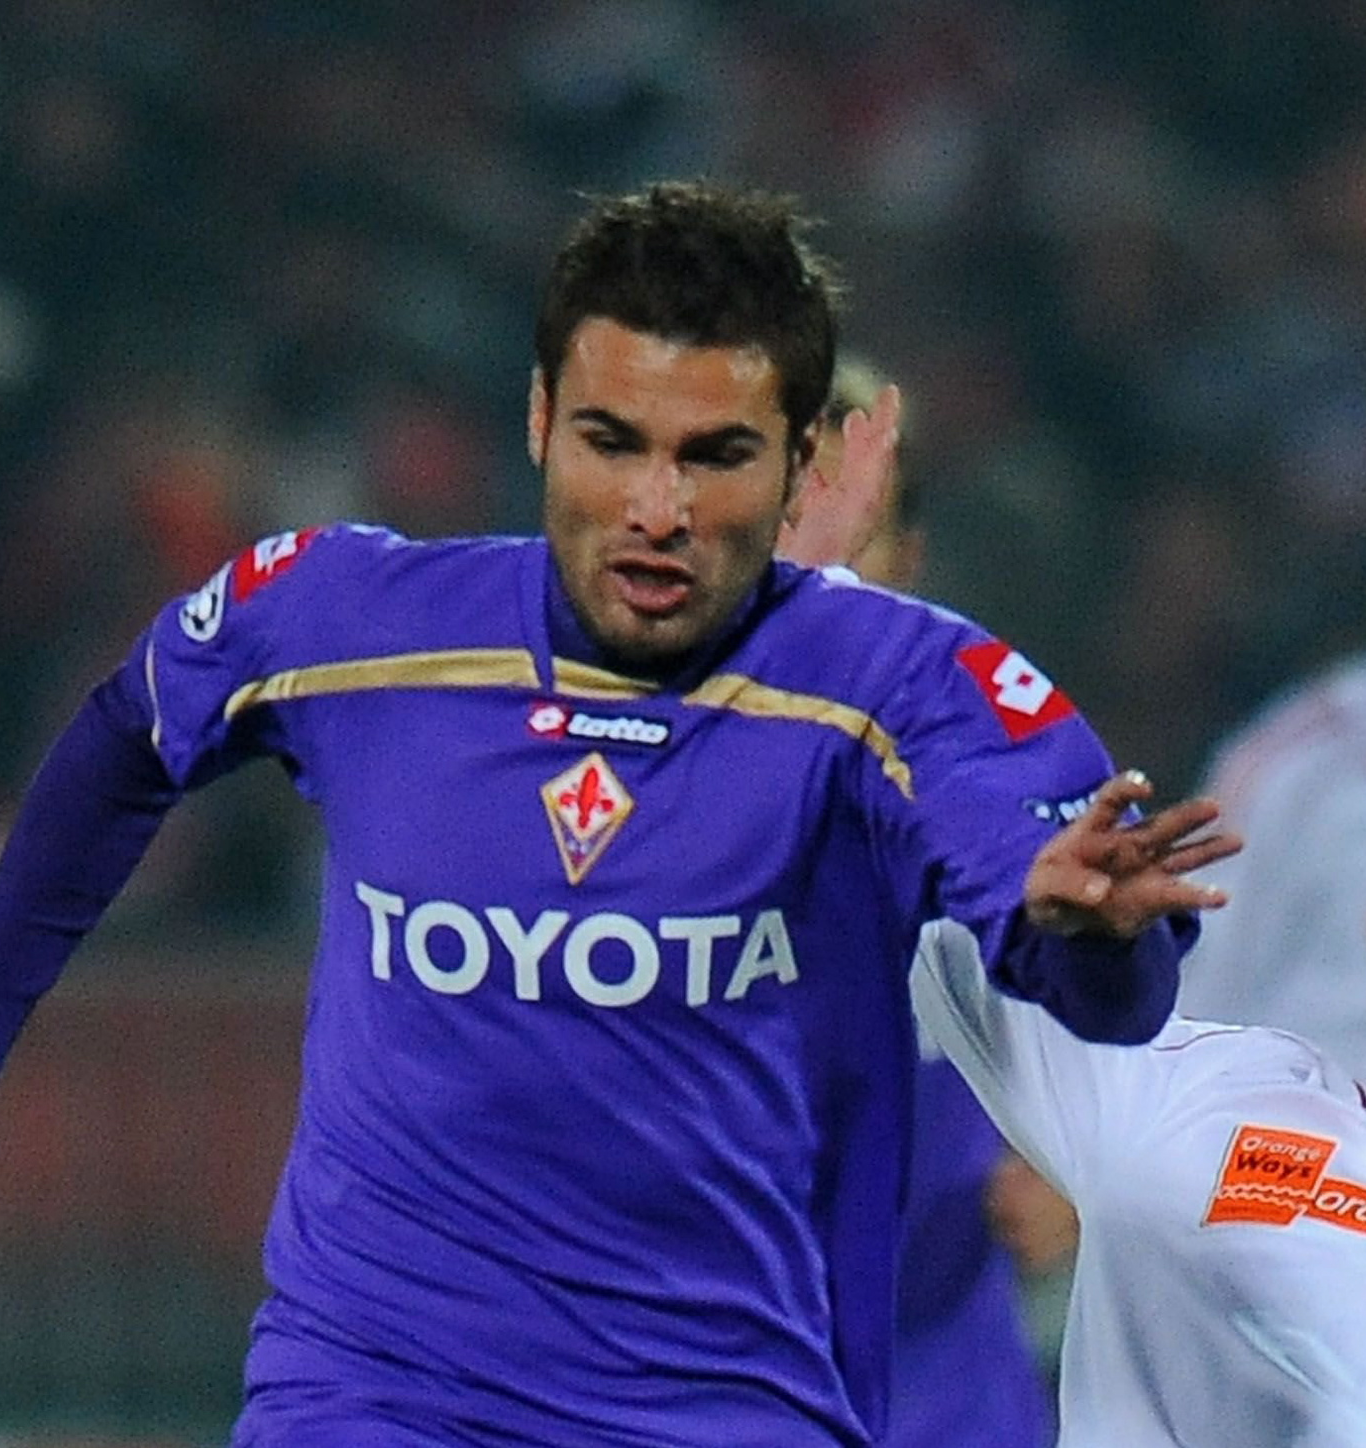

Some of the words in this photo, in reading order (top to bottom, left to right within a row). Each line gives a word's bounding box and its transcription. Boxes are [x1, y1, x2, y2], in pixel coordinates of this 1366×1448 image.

[355, 879, 799, 1007] TOYOTA
[1241, 1135, 1322, 1163] Orange
[1236, 1152, 1314, 1181] Ways
